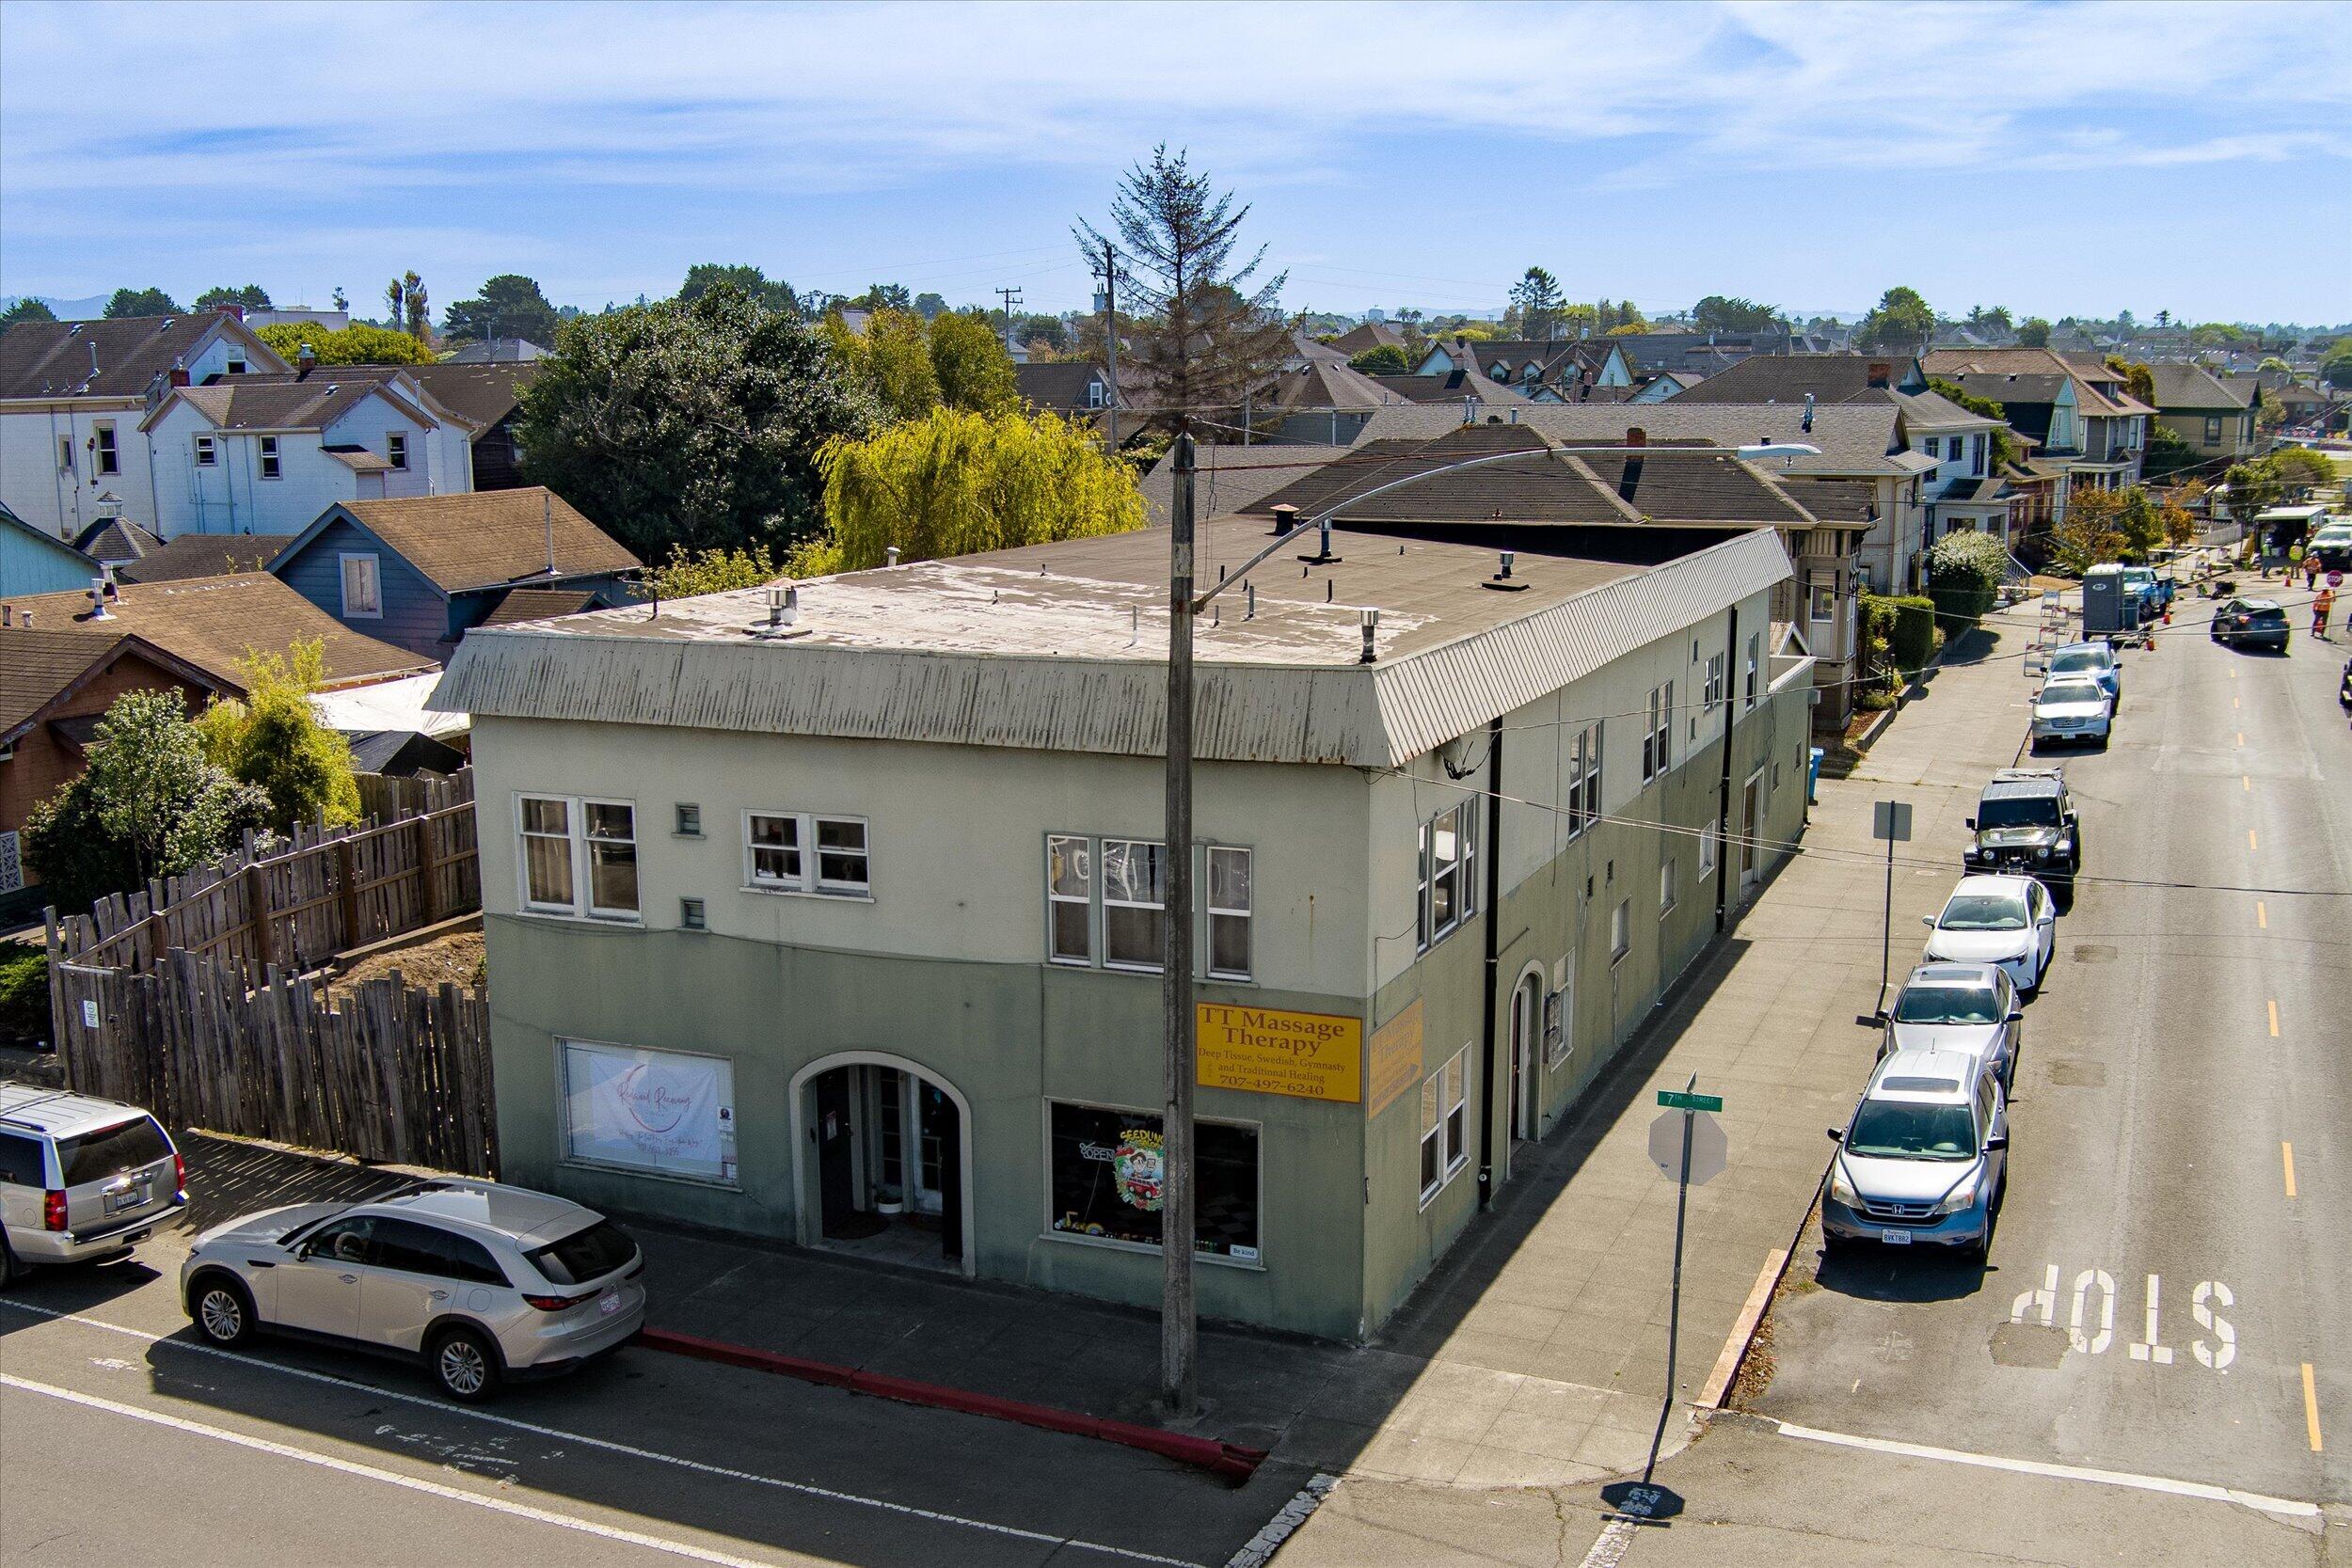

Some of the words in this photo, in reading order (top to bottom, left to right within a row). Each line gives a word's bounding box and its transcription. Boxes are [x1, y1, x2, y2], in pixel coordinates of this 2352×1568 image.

[1200, 1006, 1234, 1025] TT
[1242, 1011, 1344, 1041] Massage
[1222, 1026, 1323, 1057] Therapy
[1199, 1047, 1221, 1060] Deep
[1223, 1050, 1255, 1063] Tissue,
[1257, 1053, 1297, 1067] Swedish,
[1299, 1058, 1345, 1073] Gymnasty
[1218, 1063, 1234, 1072] and
[1236, 1064, 1287, 1078] Traditional
[1289, 1070, 1325, 1084] Healing
[1219, 1074, 1324, 1096] 707-497-6240
[1667, 1093, 1682, 1105] 7TH
[1087, 1148, 1114, 1161] OPEN
[2010, 1263, 2236, 1369] STOP
